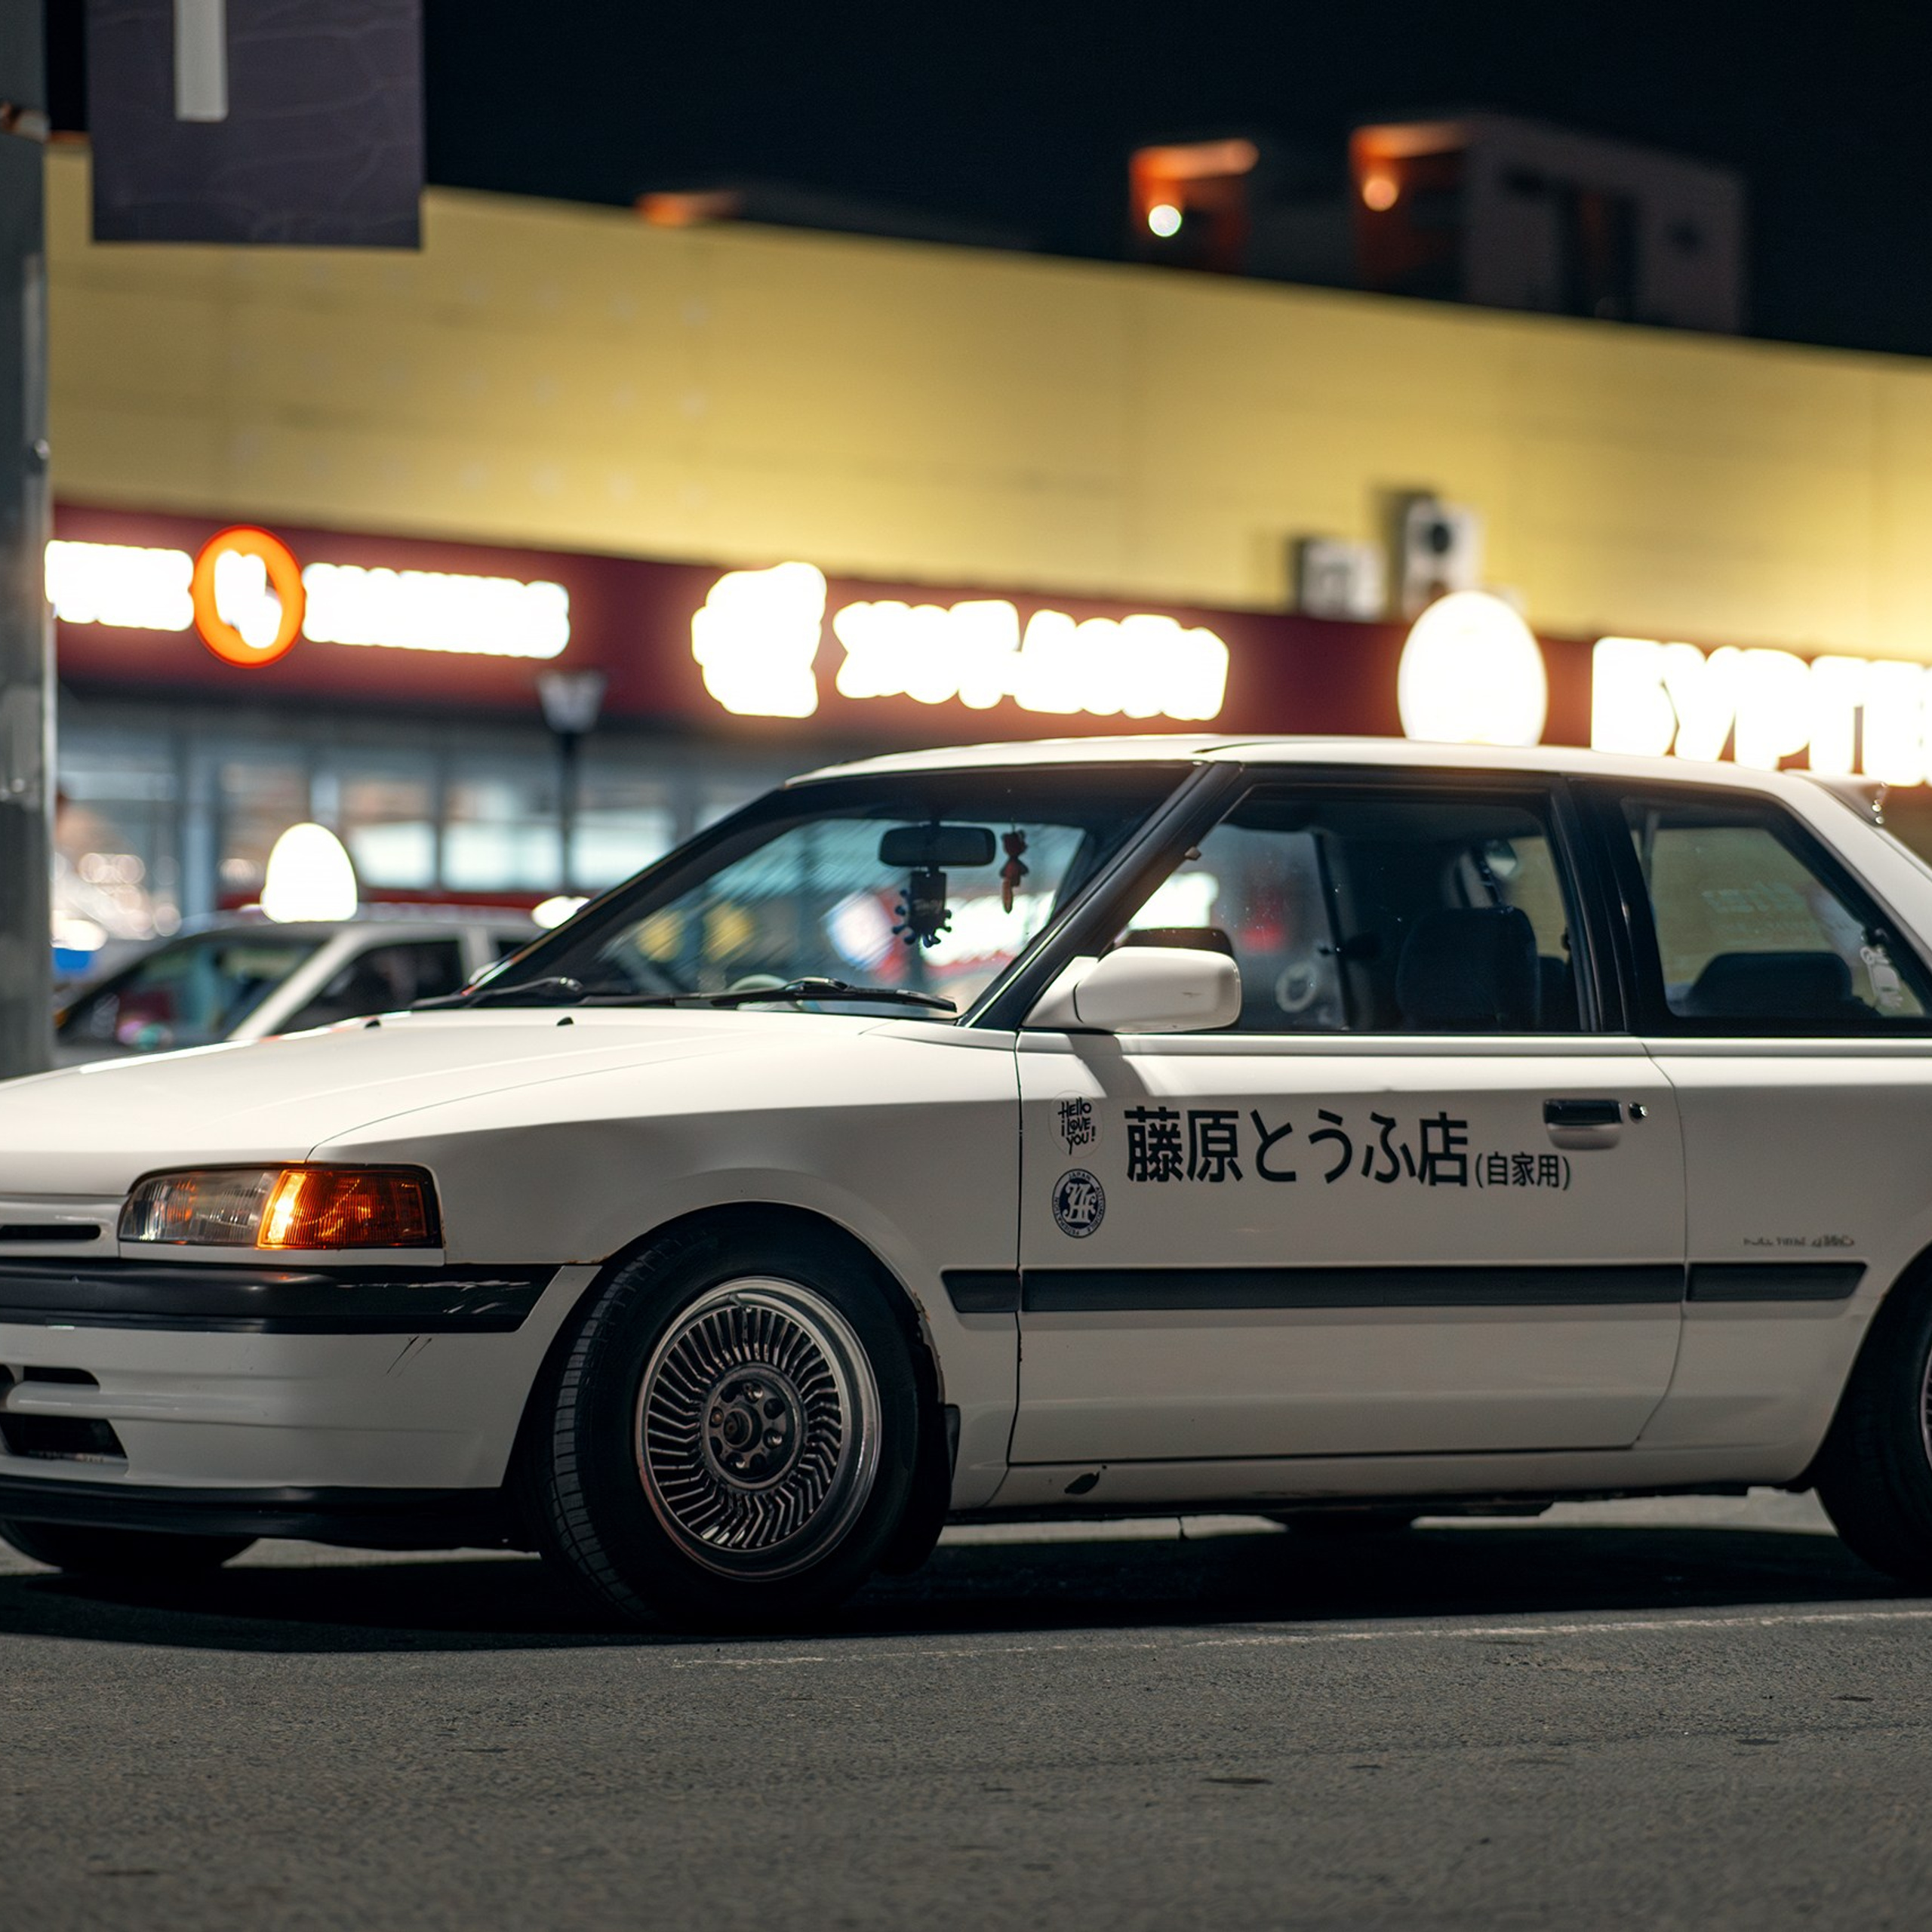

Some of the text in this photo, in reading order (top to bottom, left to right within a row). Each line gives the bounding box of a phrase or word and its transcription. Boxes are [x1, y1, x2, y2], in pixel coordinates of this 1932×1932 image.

[1592, 635, 1932, 786] БУРГЕ
[1067, 1117, 1091, 1136] LOVE
[1124, 1106, 1571, 1191] 藤原とうふ店 (自家用)
